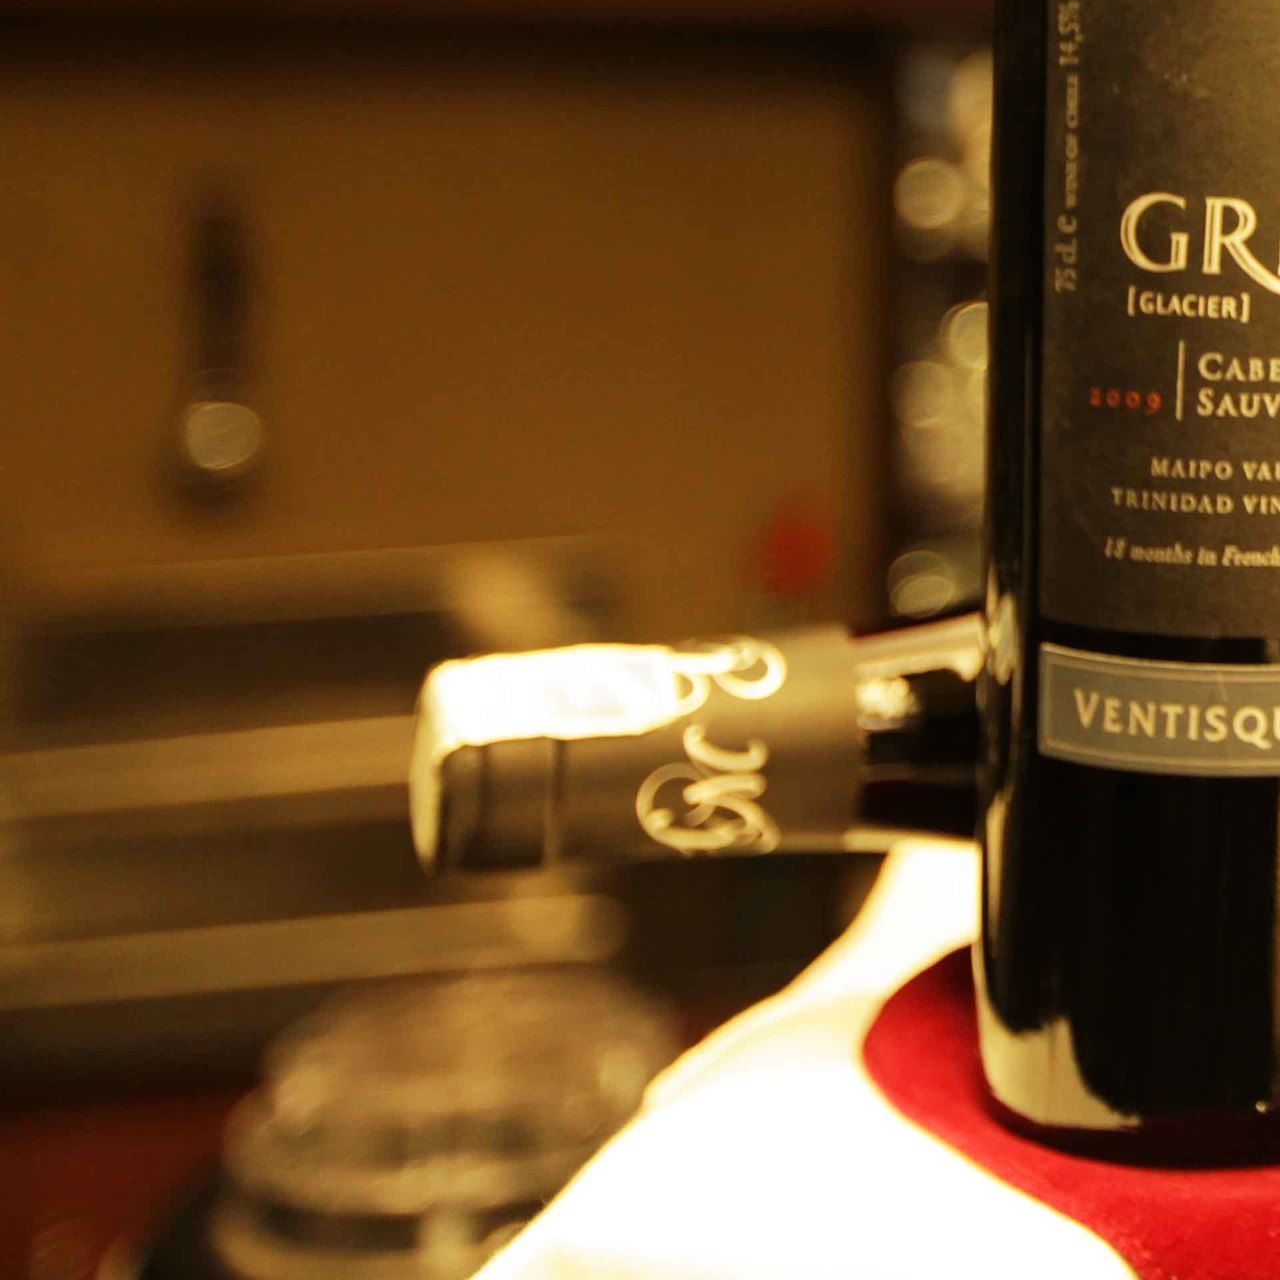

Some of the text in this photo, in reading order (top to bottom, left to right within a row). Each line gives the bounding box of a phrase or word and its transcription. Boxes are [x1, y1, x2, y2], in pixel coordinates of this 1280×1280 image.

[1089, 386, 1162, 416] 2009
[1151, 457, 1234, 481] MAIPO
[1110, 486, 1234, 515] TRINIDAD
[1130, 541, 1193, 565] months
[1197, 546, 1218, 566] in
